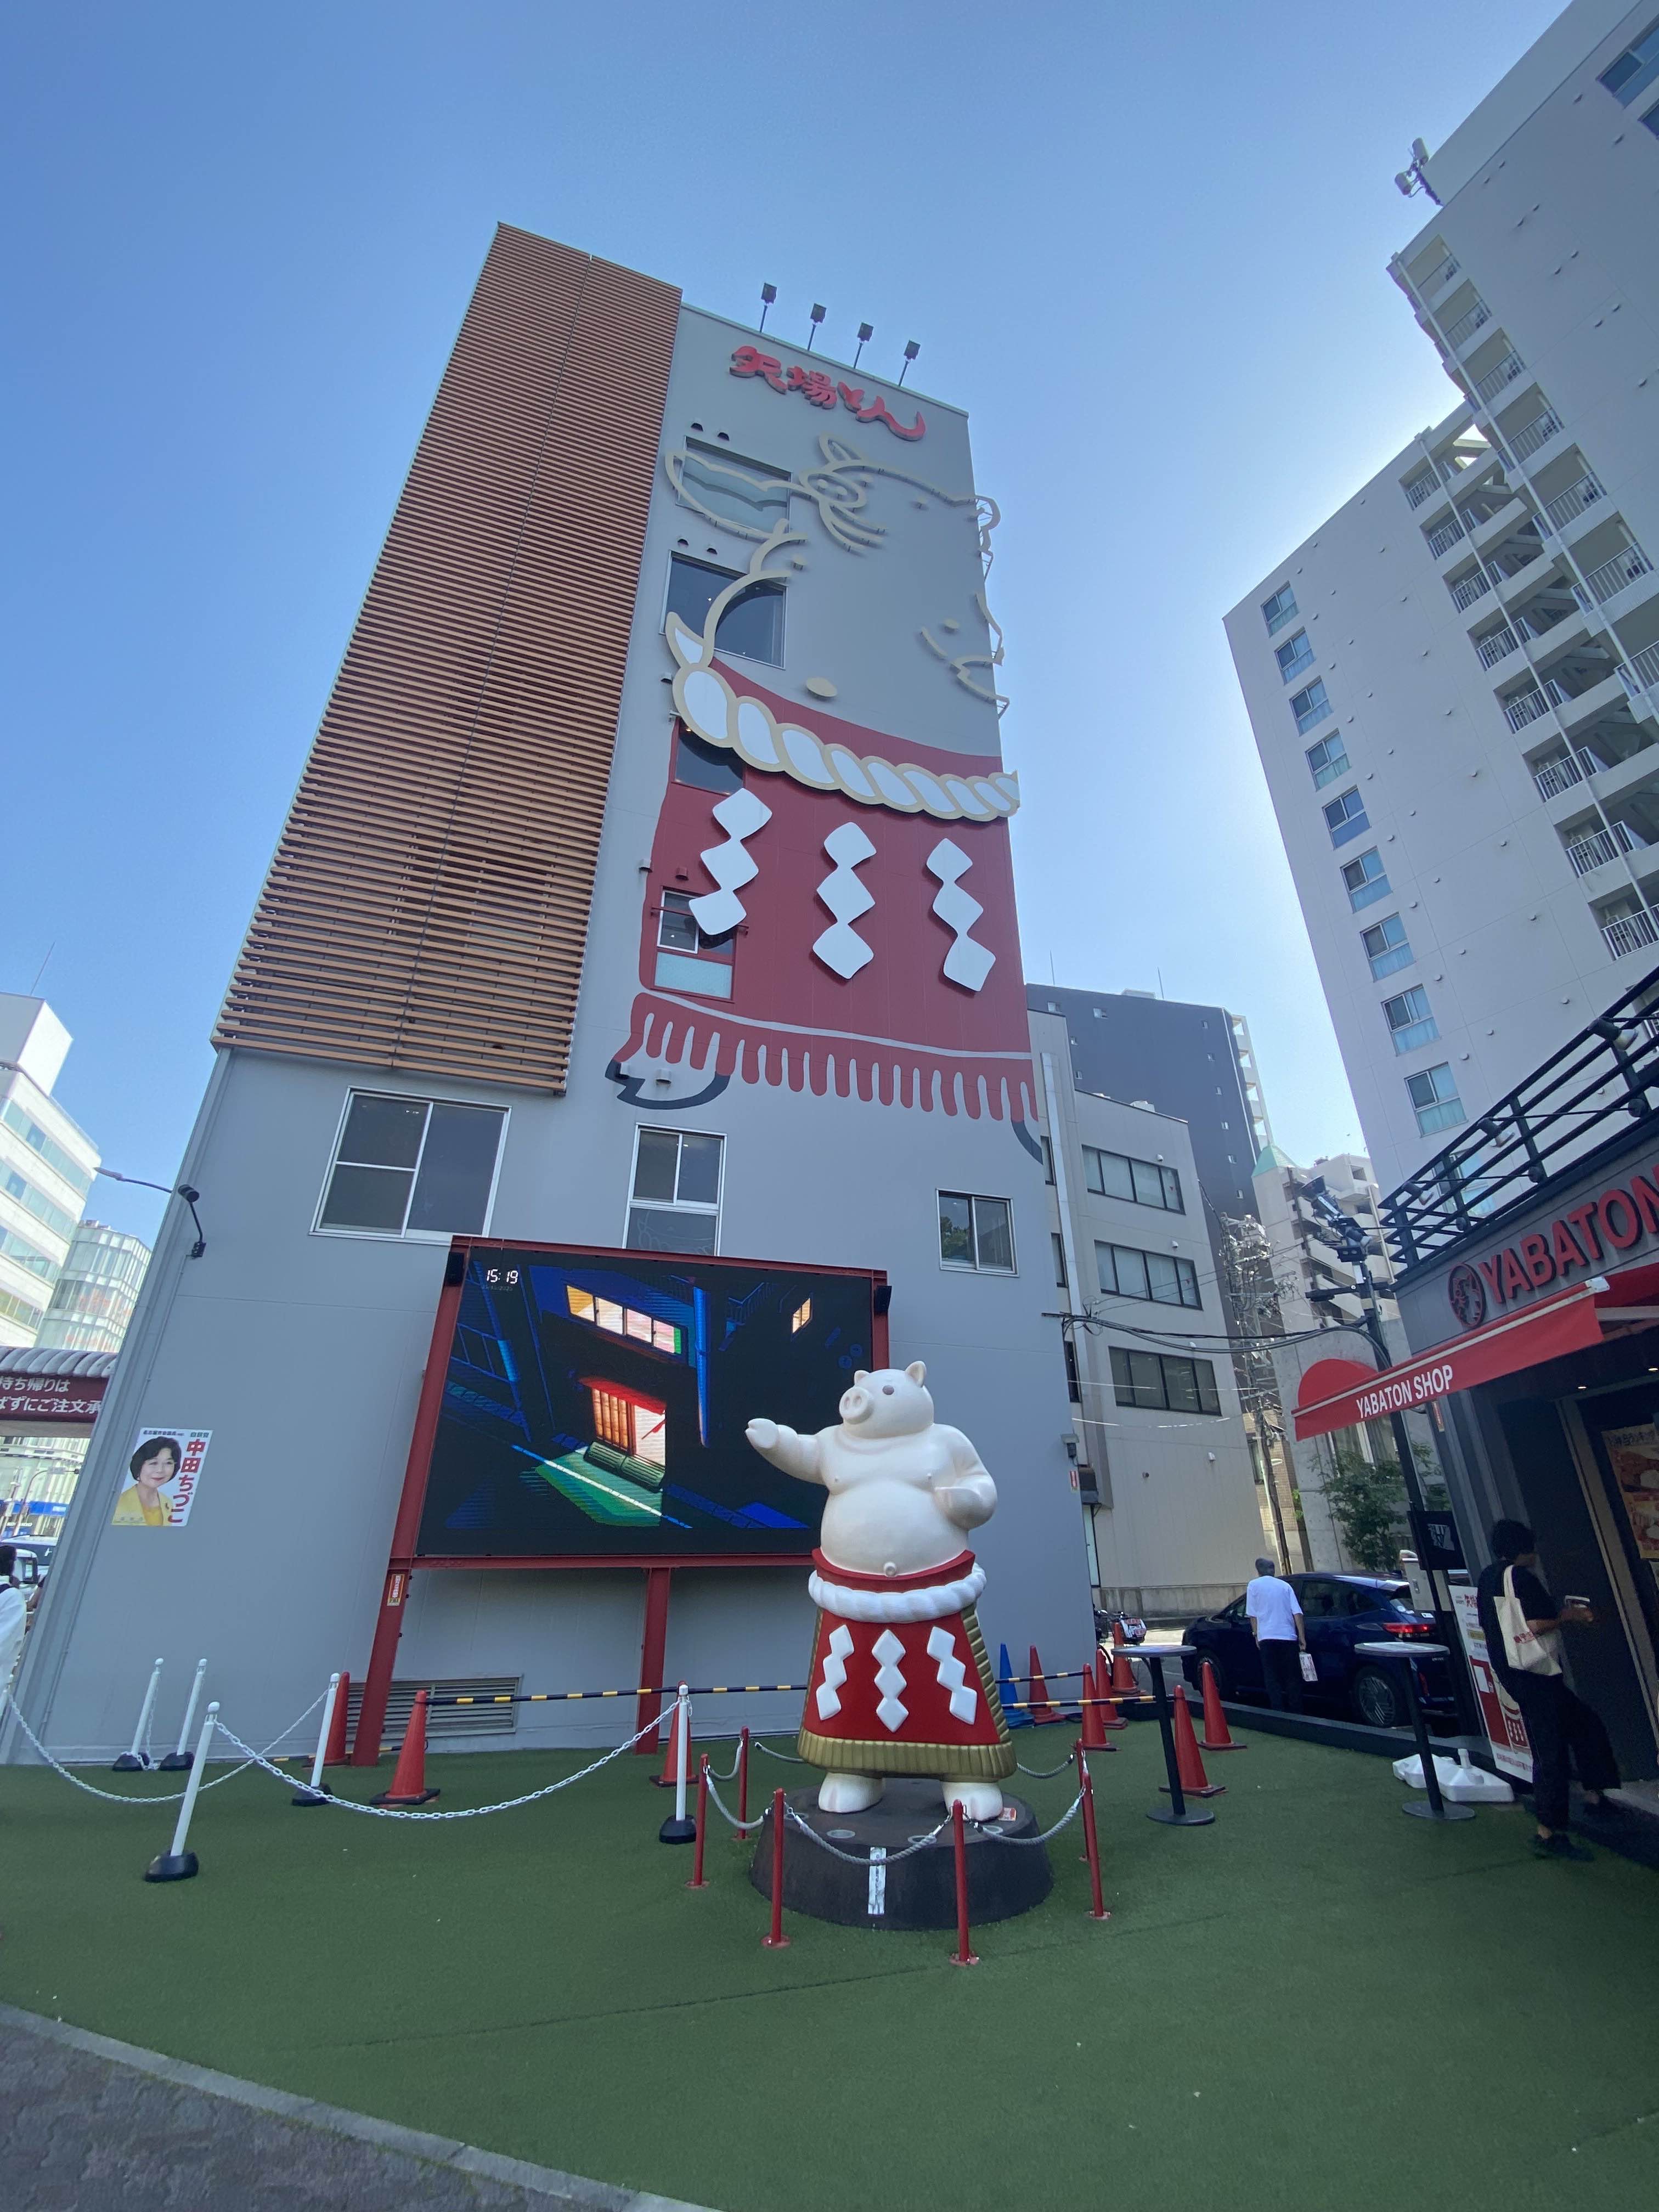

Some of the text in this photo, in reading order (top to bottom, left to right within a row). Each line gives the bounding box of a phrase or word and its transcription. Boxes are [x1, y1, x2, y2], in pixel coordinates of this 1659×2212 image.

[729, 345, 927, 442] 矢場とん
[1478, 1164, 1659, 1304] YABATON
[1356, 1380, 1413, 1419] YABATON
[1413, 1364, 1453, 1400] SHOP
[167, 1438, 206, 1523] 中田ちづこ
